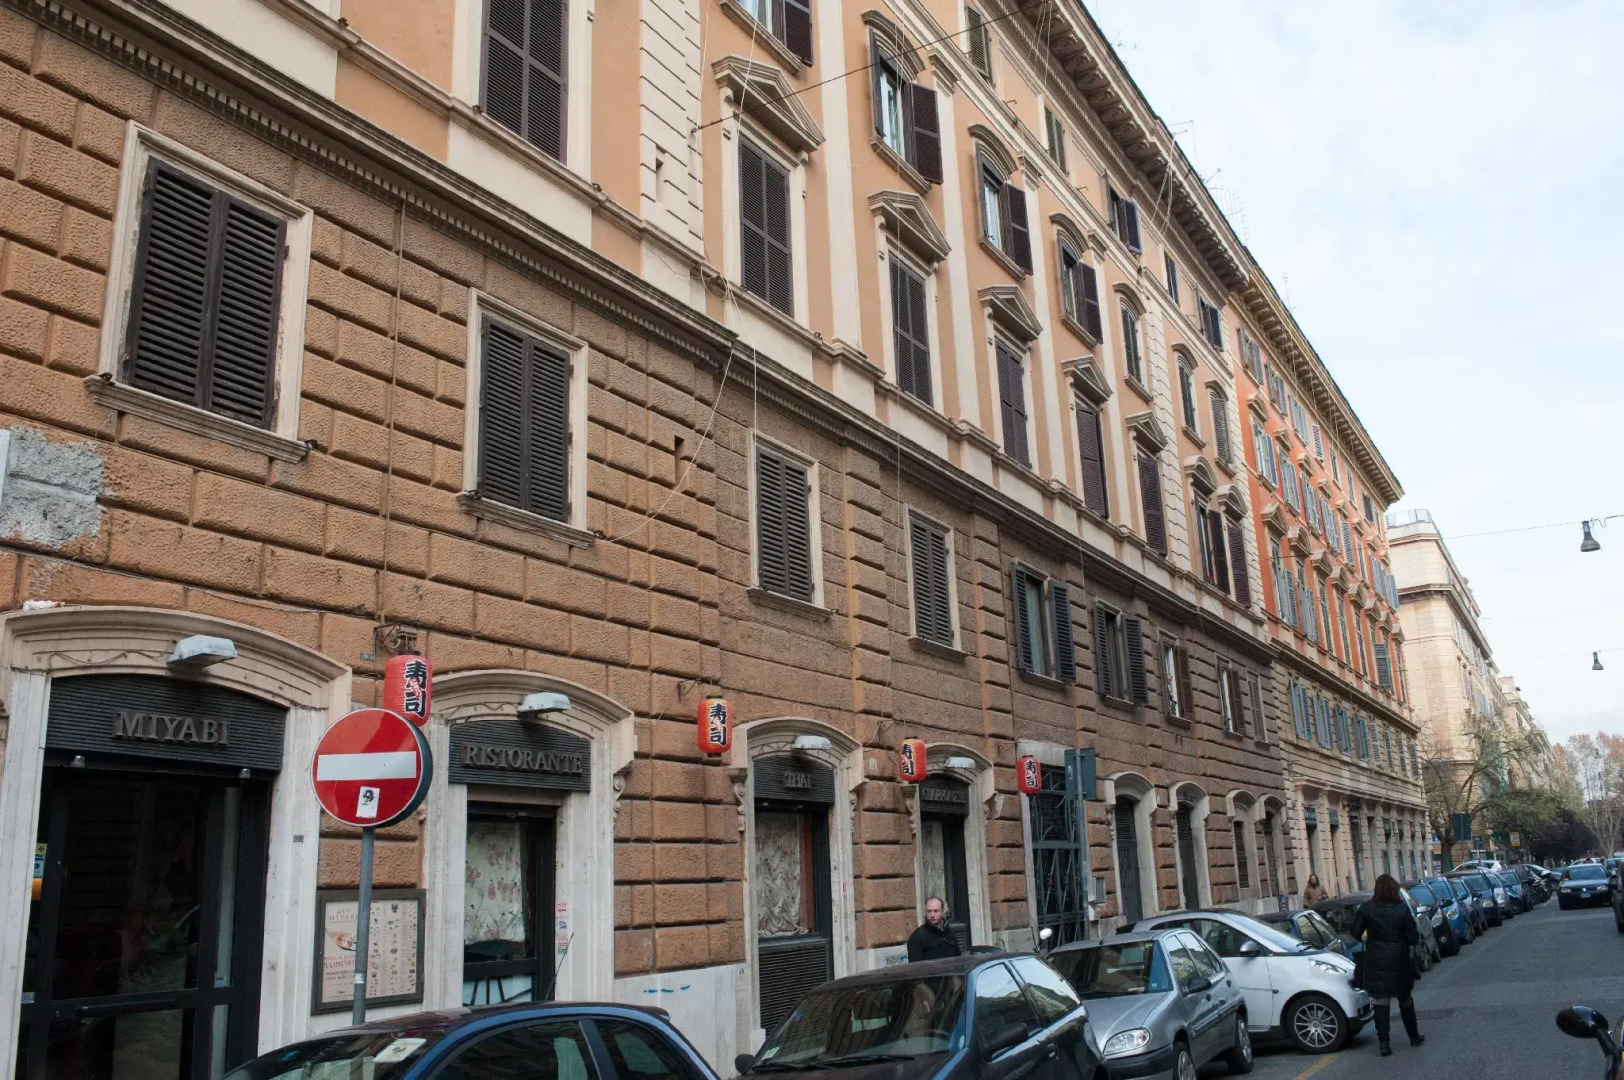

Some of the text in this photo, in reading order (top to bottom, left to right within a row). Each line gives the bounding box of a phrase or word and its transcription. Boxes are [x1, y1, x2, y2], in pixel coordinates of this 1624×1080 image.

[404, 659, 428, 718] 寿司
[113, 710, 230, 745] MIYABI
[710, 702, 727, 747] 寿司
[463, 744, 583, 773] RISTORANTE
[784, 772, 812, 789] THAI
[323, 960, 355, 969] ILLIMITAT
